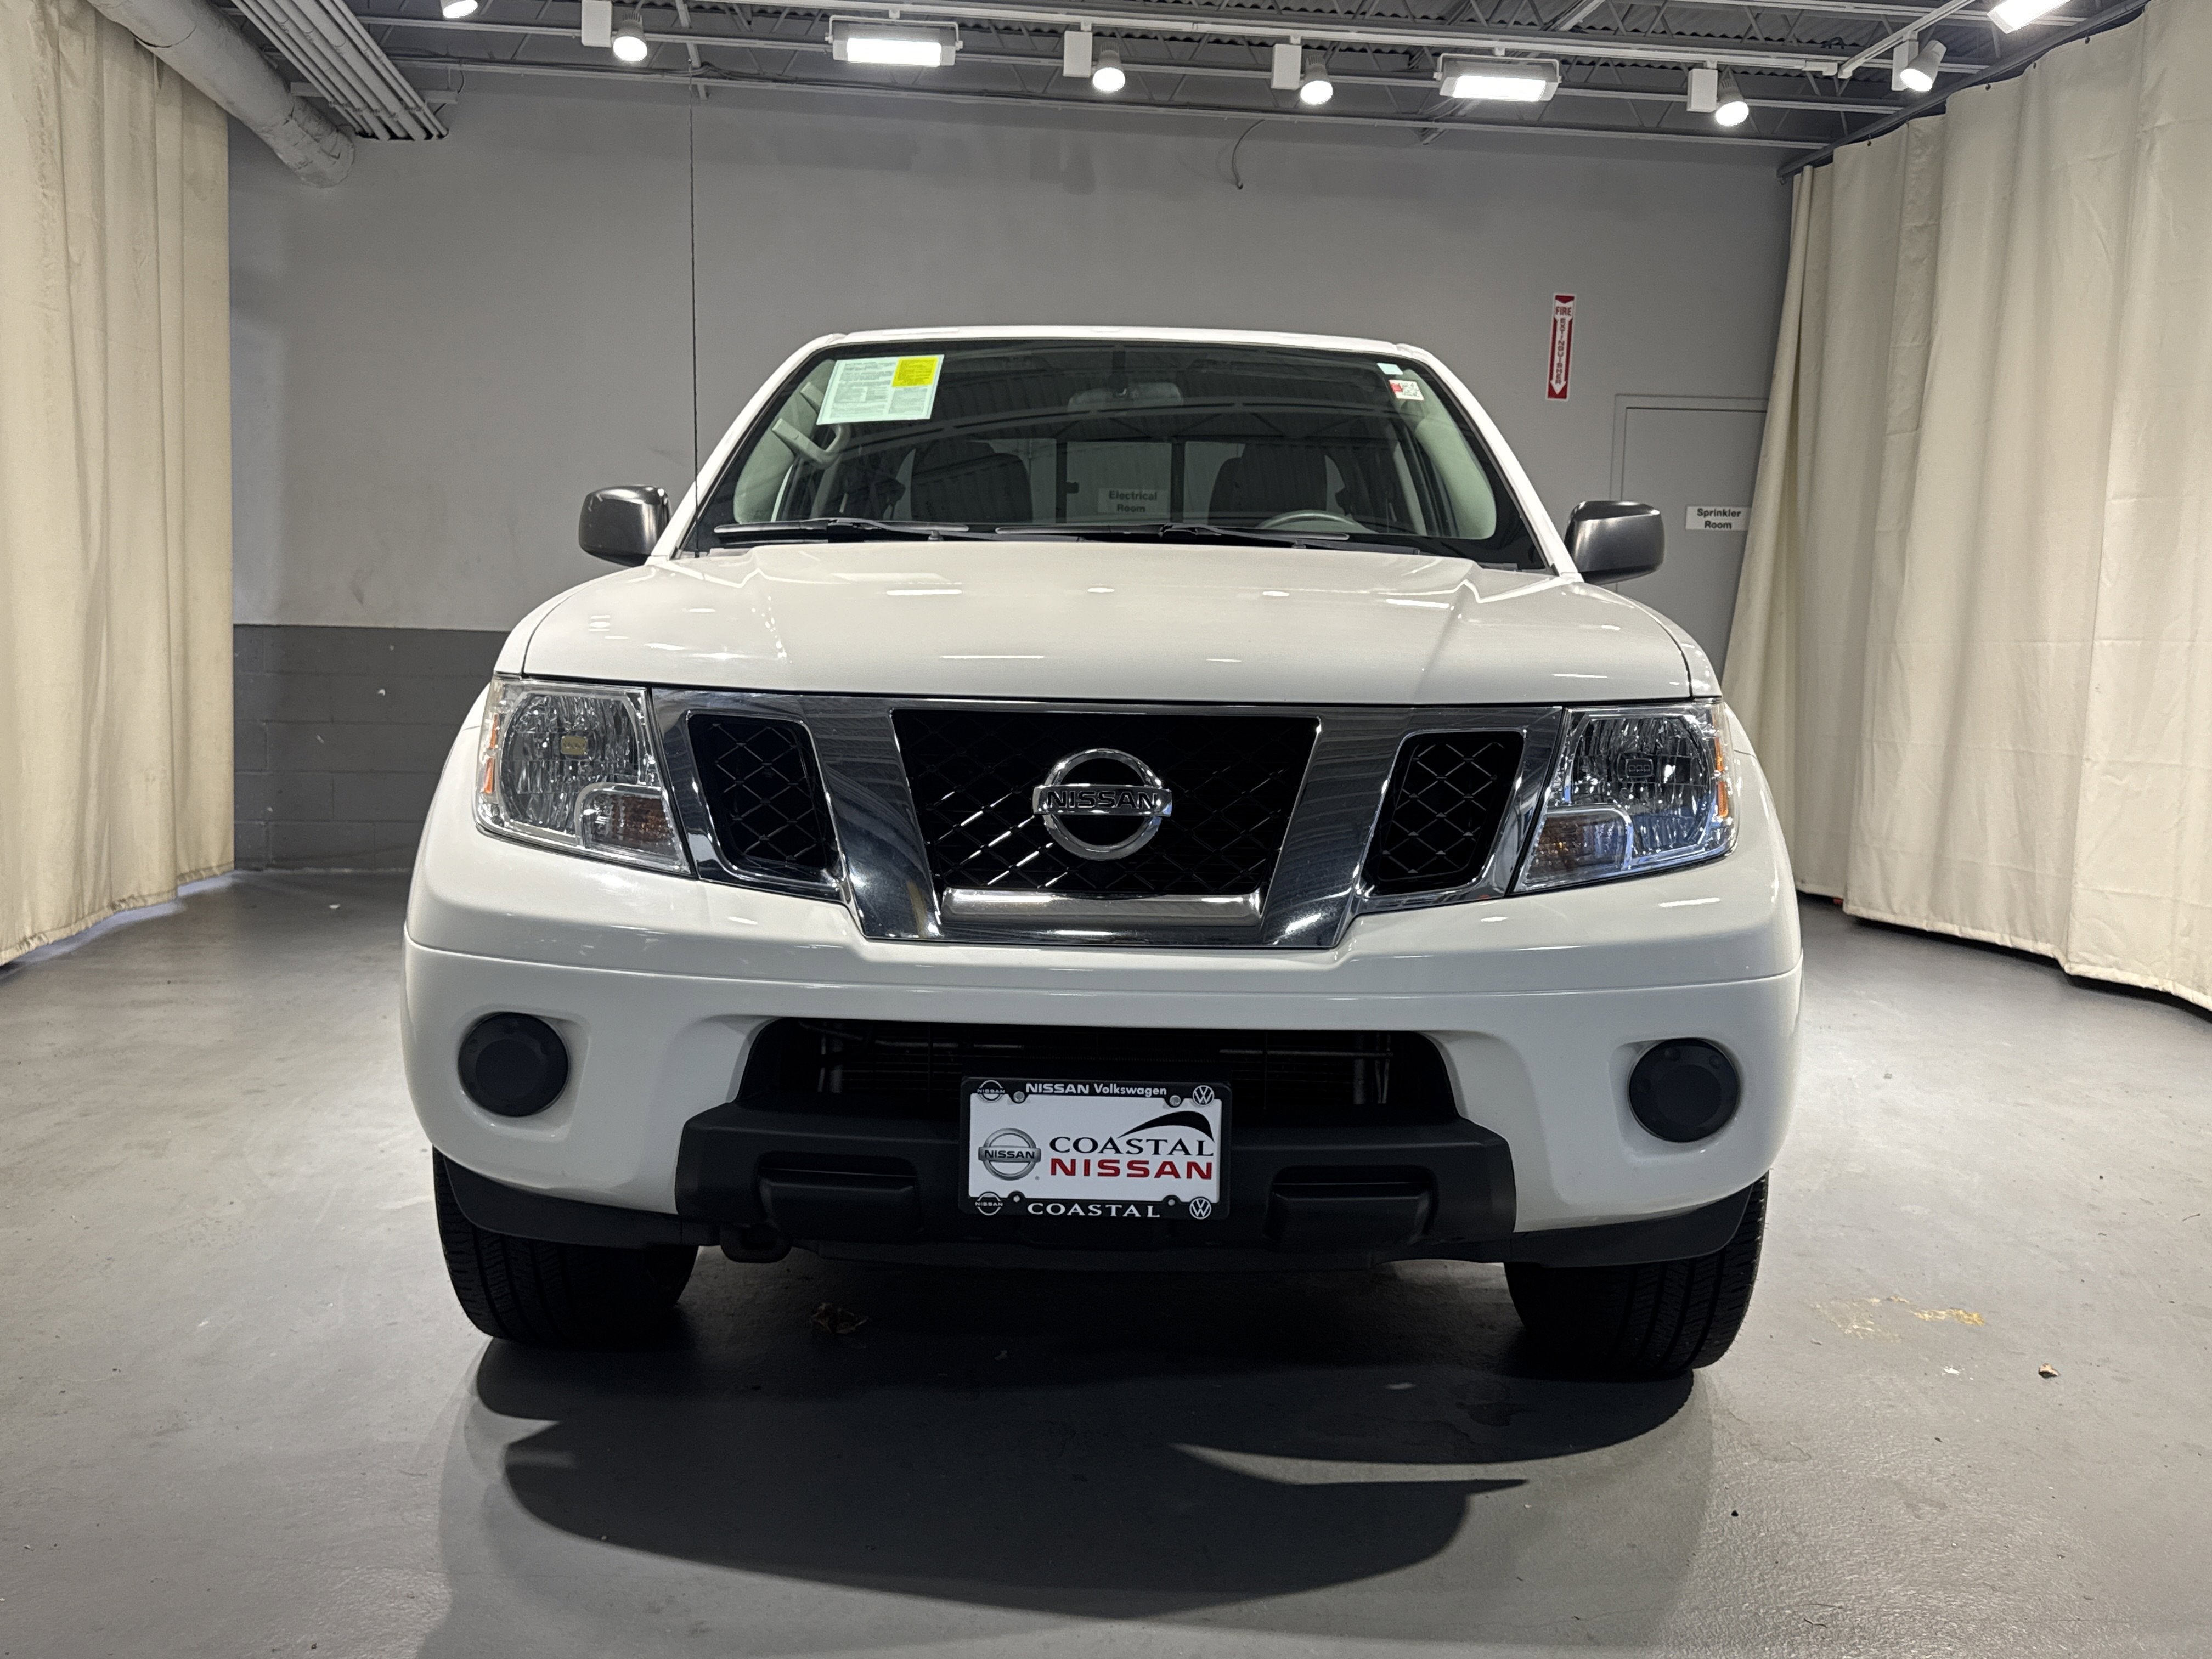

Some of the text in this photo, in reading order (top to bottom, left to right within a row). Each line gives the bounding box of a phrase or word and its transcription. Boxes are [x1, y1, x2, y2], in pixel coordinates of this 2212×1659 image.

[1555, 306, 1572, 316] FIRE
[1555, 318, 1566, 385] EXTINGUISHER
[1109, 490, 1157, 500] Electrical
[1117, 504, 1146, 512] Room
[1697, 508, 1741, 518] Sprinkler
[1705, 521, 1732, 529] Room
[1047, 791, 1157, 809] NISSAN
[1026, 1083, 1167, 1097] NISSAN Volkswagen
[1049, 1136, 1214, 1156] COASTAL
[984, 1149, 1035, 1159] NISSAN
[1050, 1158, 1212, 1180] NISSAN
[1027, 1203, 1160, 1218] COASTAL
